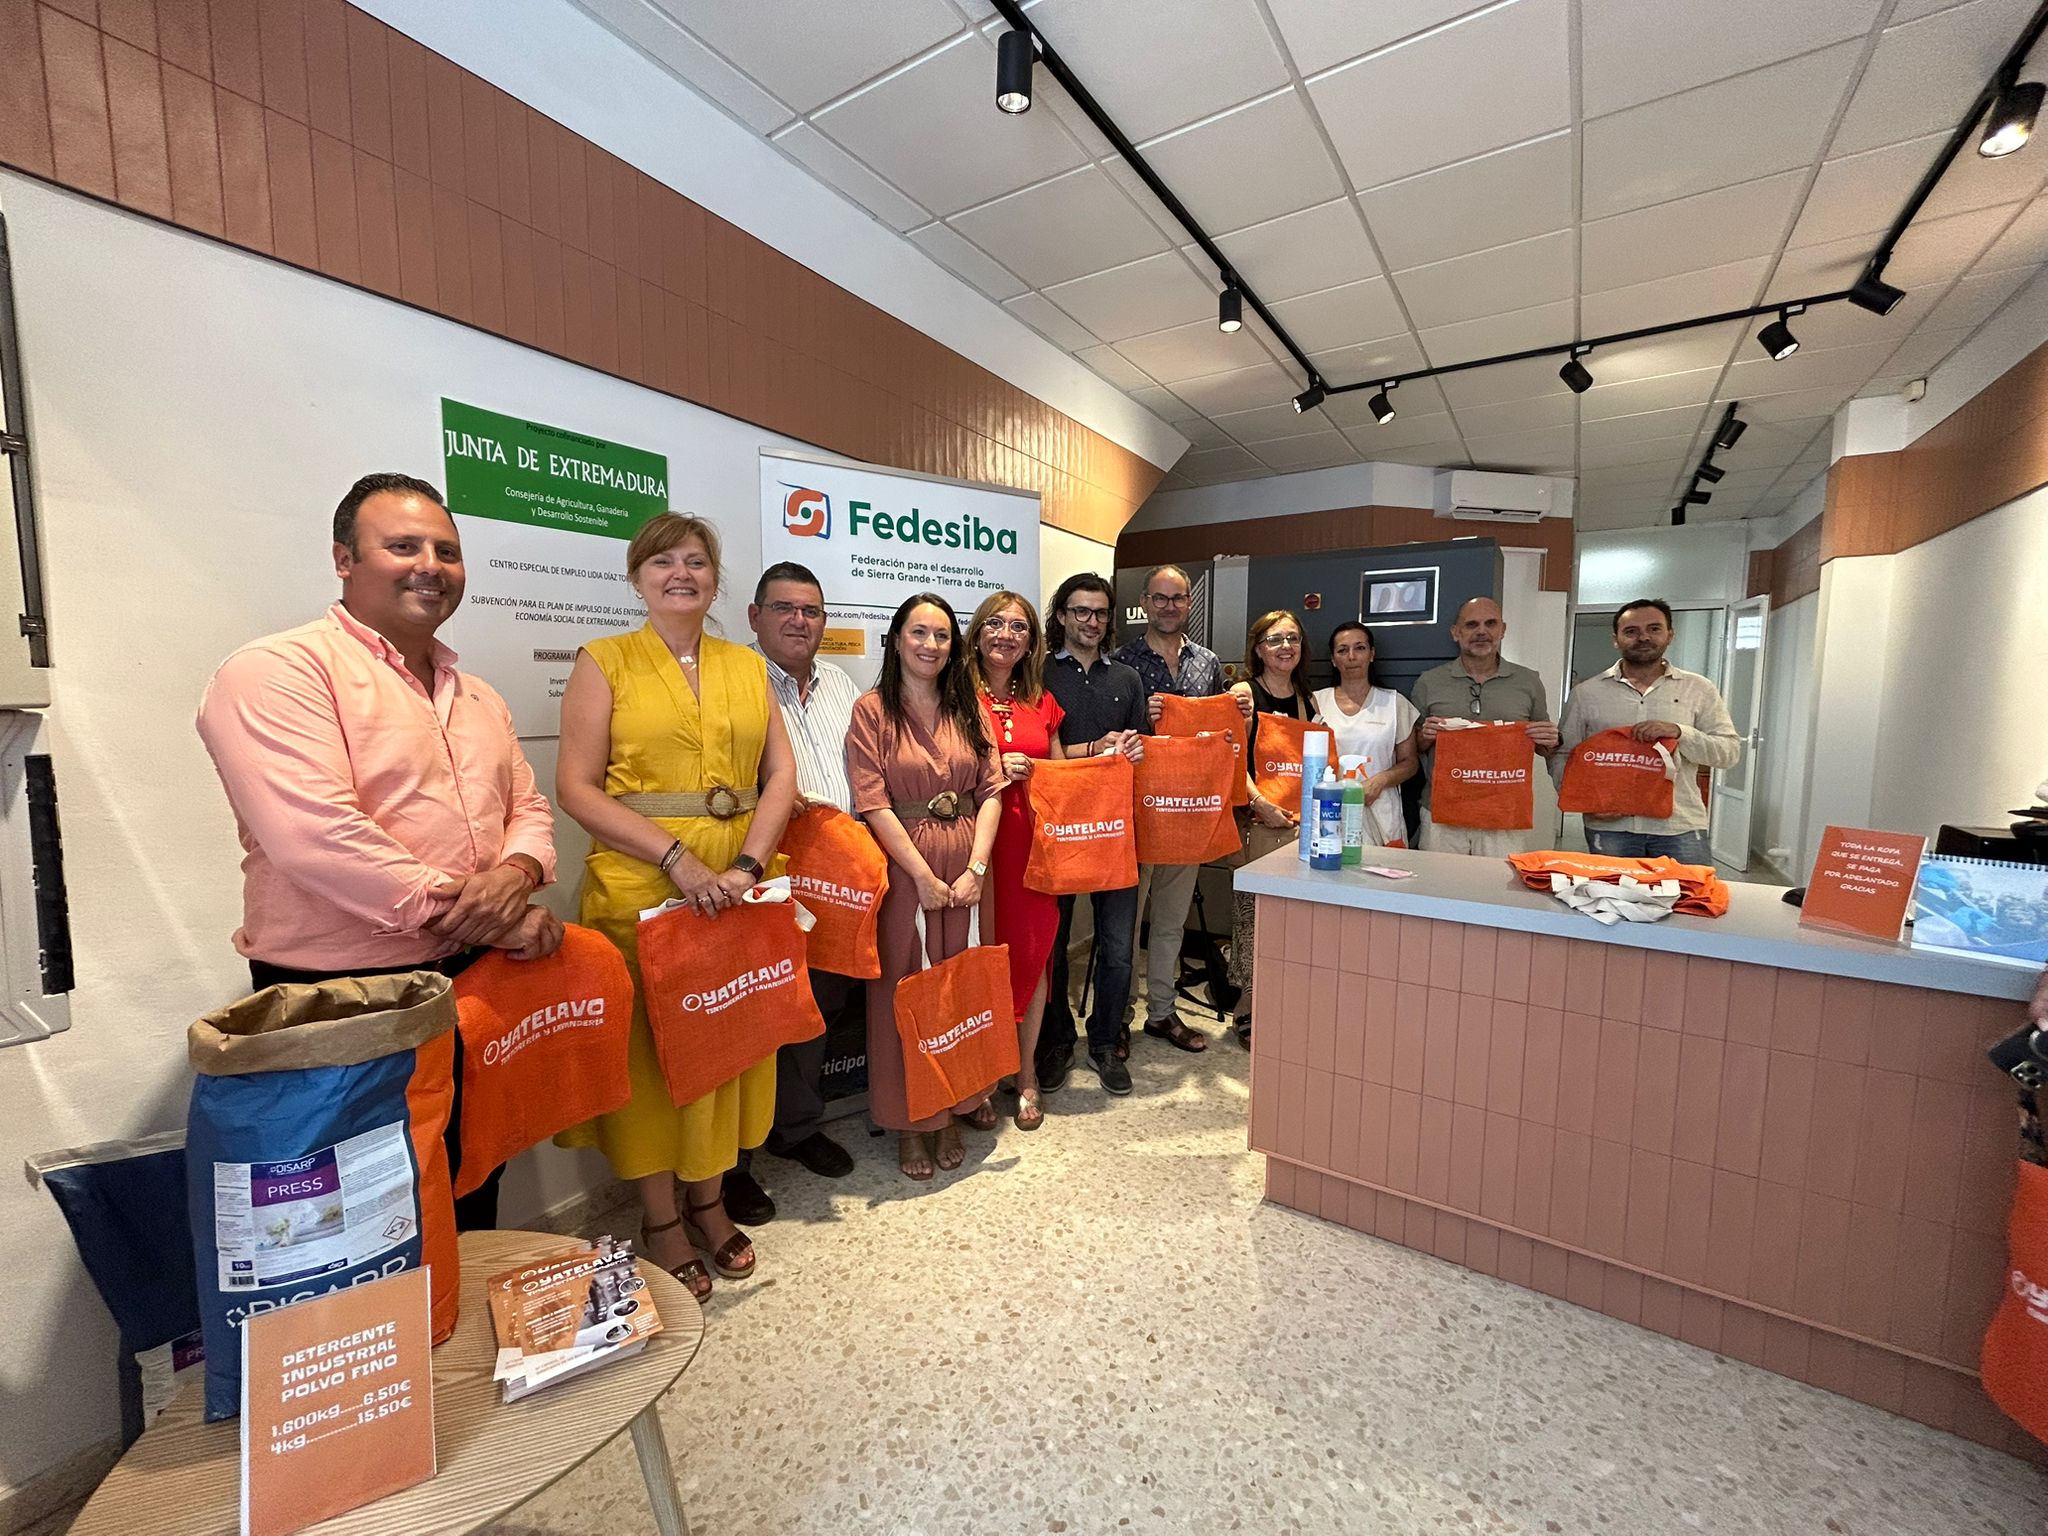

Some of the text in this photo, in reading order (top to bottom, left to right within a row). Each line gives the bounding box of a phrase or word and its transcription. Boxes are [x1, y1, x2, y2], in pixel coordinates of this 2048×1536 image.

[526, 421, 607, 450] Proyecto cofinanciado por
[445, 429, 668, 499] JUNTA DE EXTREMADURA
[505, 486, 544, 502] Consejería
[545, 494, 555, 504] de
[556, 496, 596, 513] Agricultura,
[531, 506, 609, 528] y Desarrollo Sostenible
[849, 500, 1018, 555] Fedesiba
[490, 559, 518, 570] CENTRO
[519, 562, 550, 574] ESPECIAL
[551, 566, 559, 574] DE
[561, 567, 587, 577] EMPLEO
[588, 569, 603, 579] LIDIA
[603, 570, 618, 581] DÍAZ
[851, 554, 985, 577] Federación para el desarrollo
[851, 568, 865, 578] de
[867, 568, 895, 581] Sierra
[964, 577, 976, 588] de
[978, 579, 1005, 591] Barros
[471, 595, 649, 617] SUBVENCIÓN PARA EL PLAN DE IMPULSO DE LAS ENTIDAD
[515, 612, 629, 627] ECONOMÍA SOCIAL DE EXTREMADURA
[533, 651, 571, 660] PROGRAMA
[1595, 752, 1664, 767] YATELAVO
[1462, 768, 1526, 779] YATELAVO
[1155, 794, 1222, 807] YATELAVO
[1055, 819, 1125, 836] YATELAVO
[1831, 850, 1848, 858] QUE
[1840, 841, 1862, 851] TODA
[1824, 870, 1841, 878] POR
[1846, 862, 1881, 874] SE PAGA
[789, 874, 875, 905] YATELAVO
[1840, 883, 1877, 895] GRACIAS
[701, 958, 793, 1007] YATELAVO
[501, 997, 605, 1055] YATELAVO
[926, 1009, 993, 1050] YATELAVO
[276, 1157, 316, 1173] DISARP
[268, 1176, 323, 1198] PRESS
[539, 1249, 627, 1287] YATELAVO
[281, 1321, 397, 1368] DETERGENTE
[281, 1338, 397, 1385] INDUSTRIAL
[281, 1353, 398, 1403] POLVO FINO
